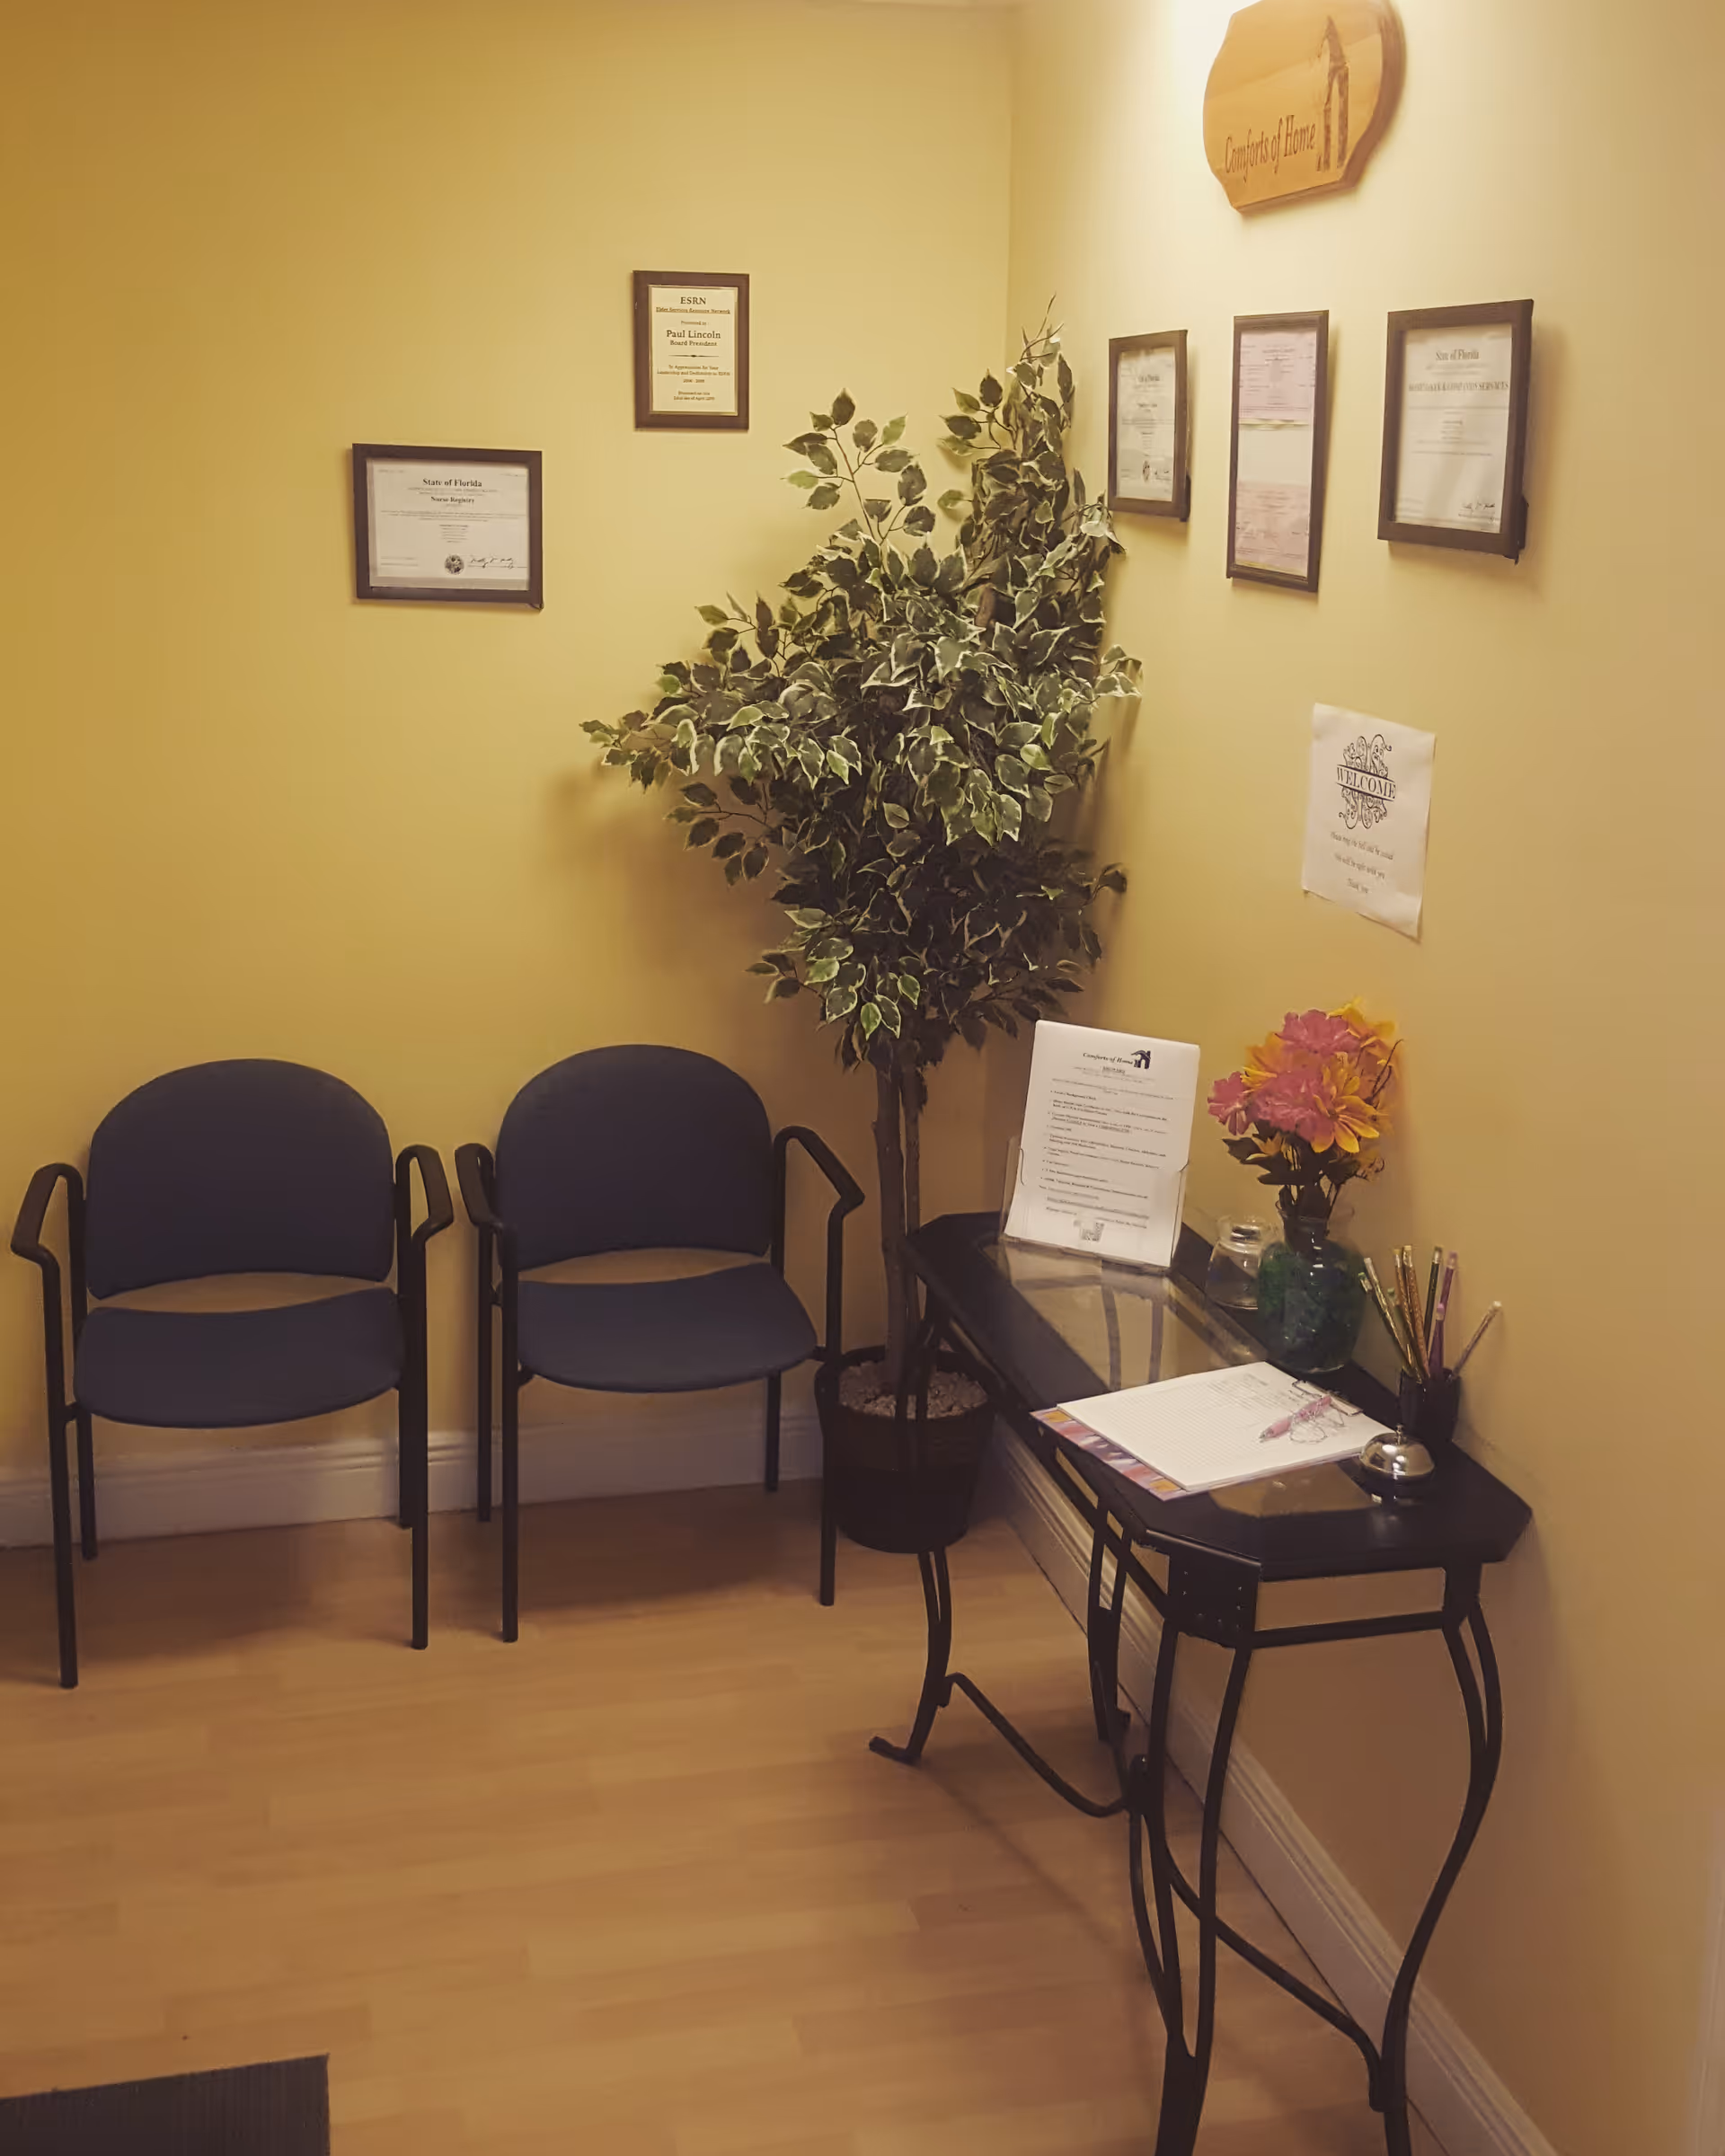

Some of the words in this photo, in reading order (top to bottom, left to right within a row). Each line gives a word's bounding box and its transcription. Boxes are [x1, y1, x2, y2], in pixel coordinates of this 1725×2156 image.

[1225, 128, 1269, 183] Comforts
[1271, 117, 1283, 174] of
[1283, 114, 1315, 157] Home
[680, 296, 706, 305] ESRN
[667, 330, 686, 338] Paul
[688, 331, 721, 339] Lincoln
[423, 478, 442, 486] State
[455, 479, 482, 487] Florida
[1337, 766, 1395, 800] WELCOME
[1083, 1052, 1109, 1062] Comforts
